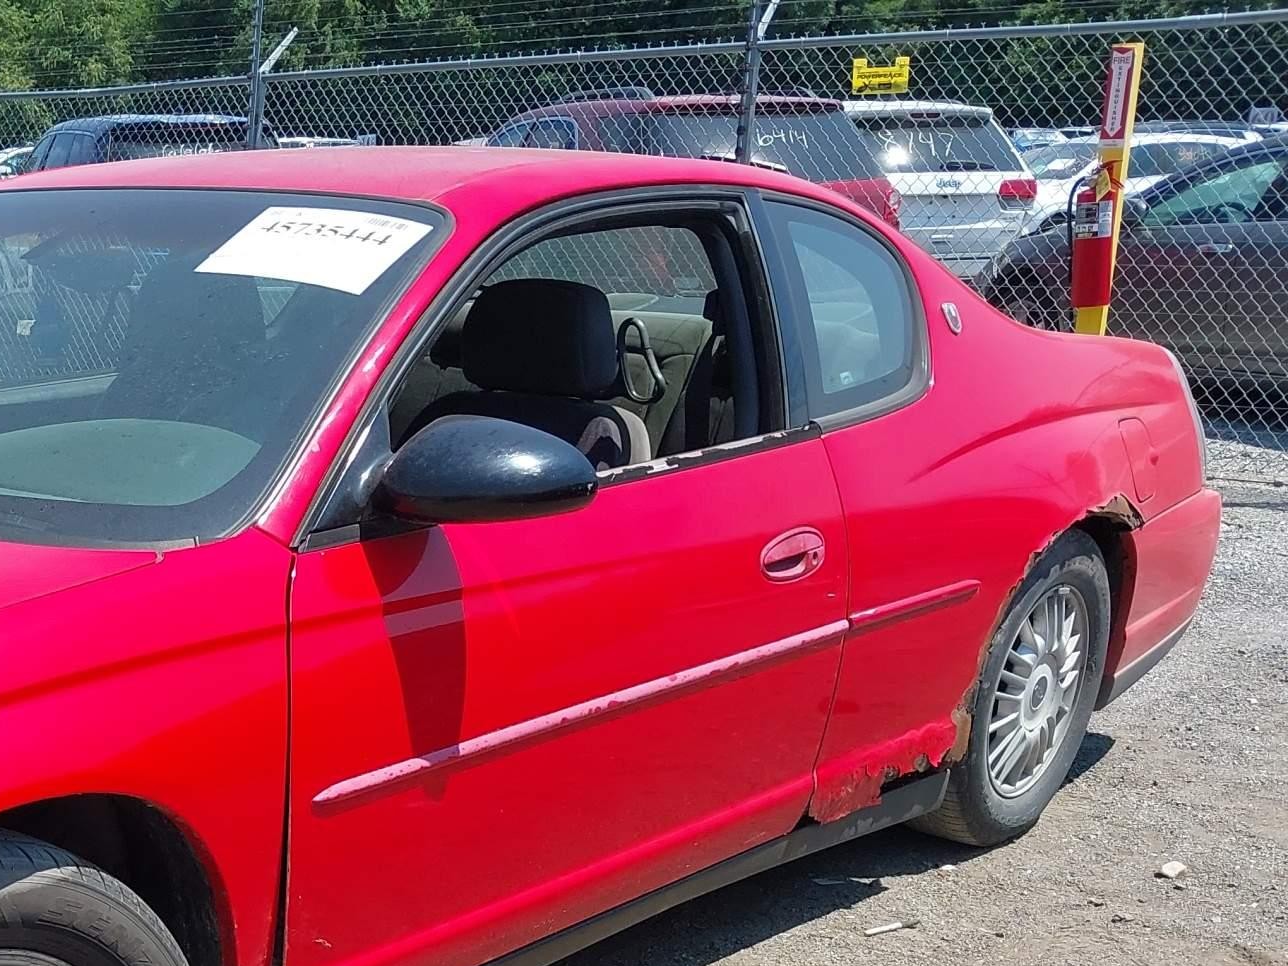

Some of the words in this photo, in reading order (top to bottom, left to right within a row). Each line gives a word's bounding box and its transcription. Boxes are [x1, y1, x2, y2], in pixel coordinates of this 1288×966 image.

[1113, 56, 1131, 65] FIRE
[1109, 65, 1123, 132] EXTINGUISHER
[755, 127, 810, 149] 6414
[935, 178, 962, 190] Jeep
[260, 220, 393, 246] 45735444
